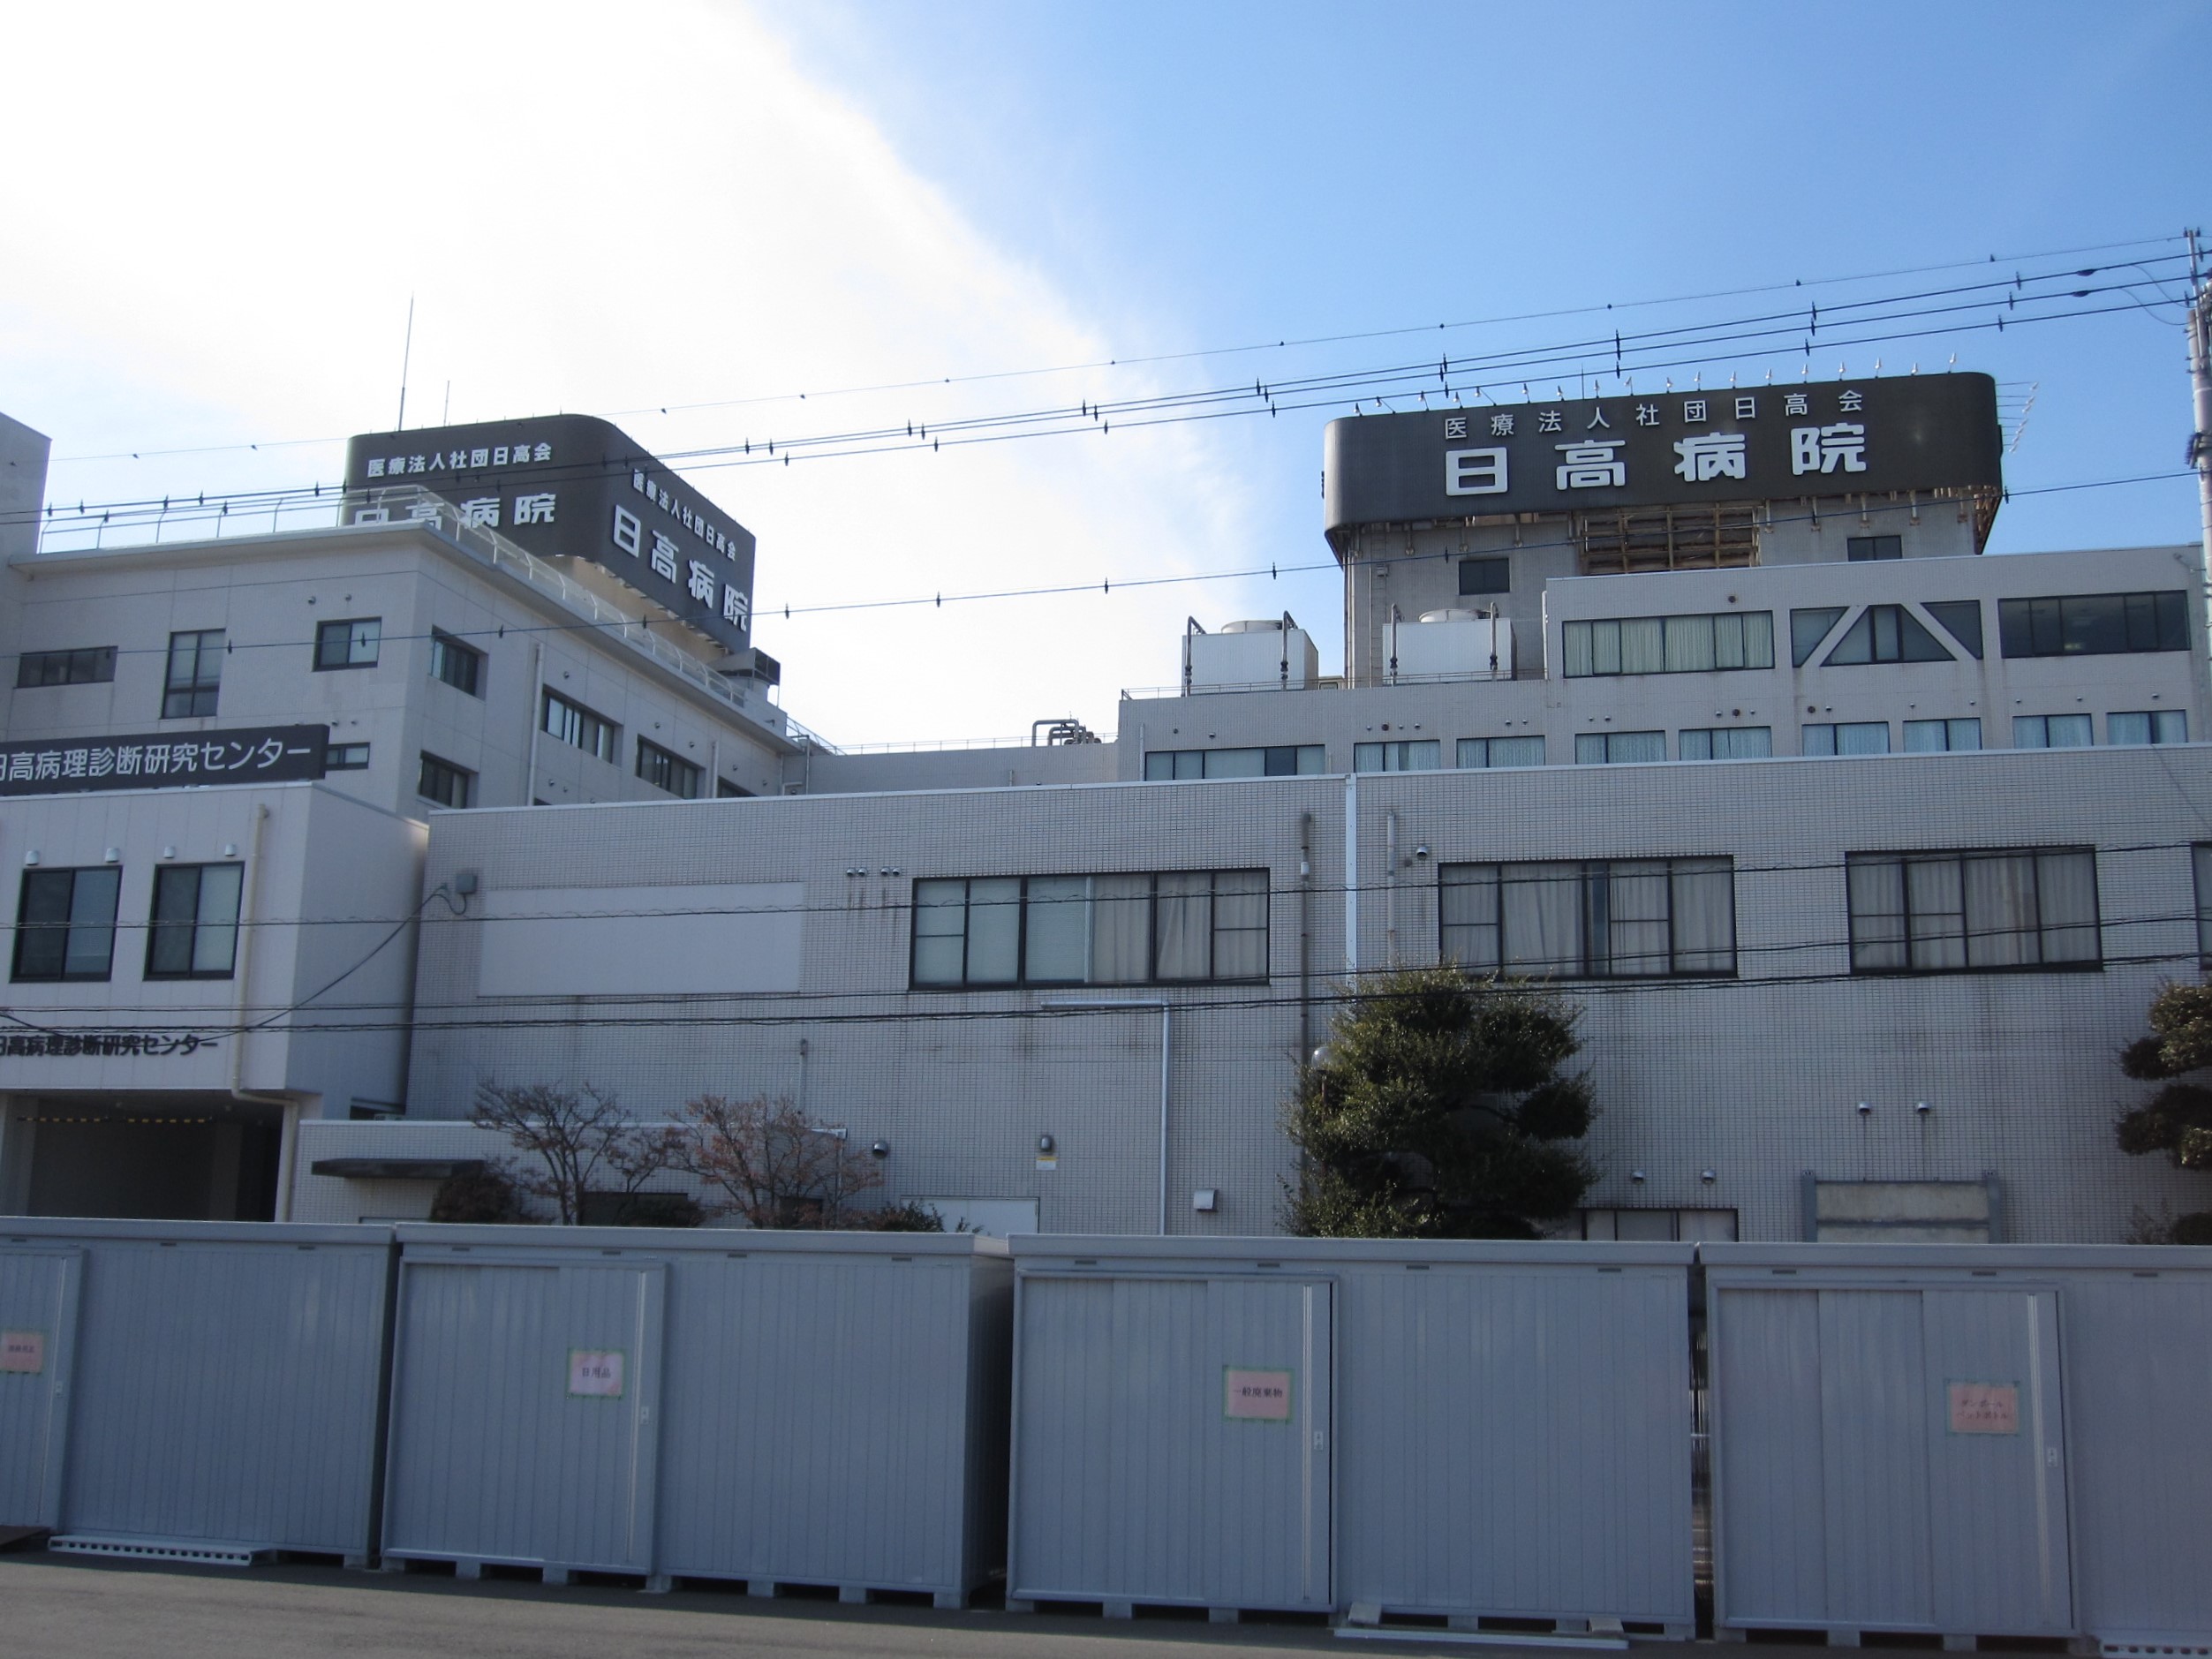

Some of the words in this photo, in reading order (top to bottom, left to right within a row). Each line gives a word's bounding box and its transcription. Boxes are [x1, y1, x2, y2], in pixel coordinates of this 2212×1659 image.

[1445, 389, 1863, 440] 医療法人社団日高会
[367, 442, 552, 479] 医療法人社団日高会
[1446, 423, 1868, 496] 日高病院
[633, 468, 736, 562] 医療法人社団日高会
[614, 504, 748, 632] 日高病院
